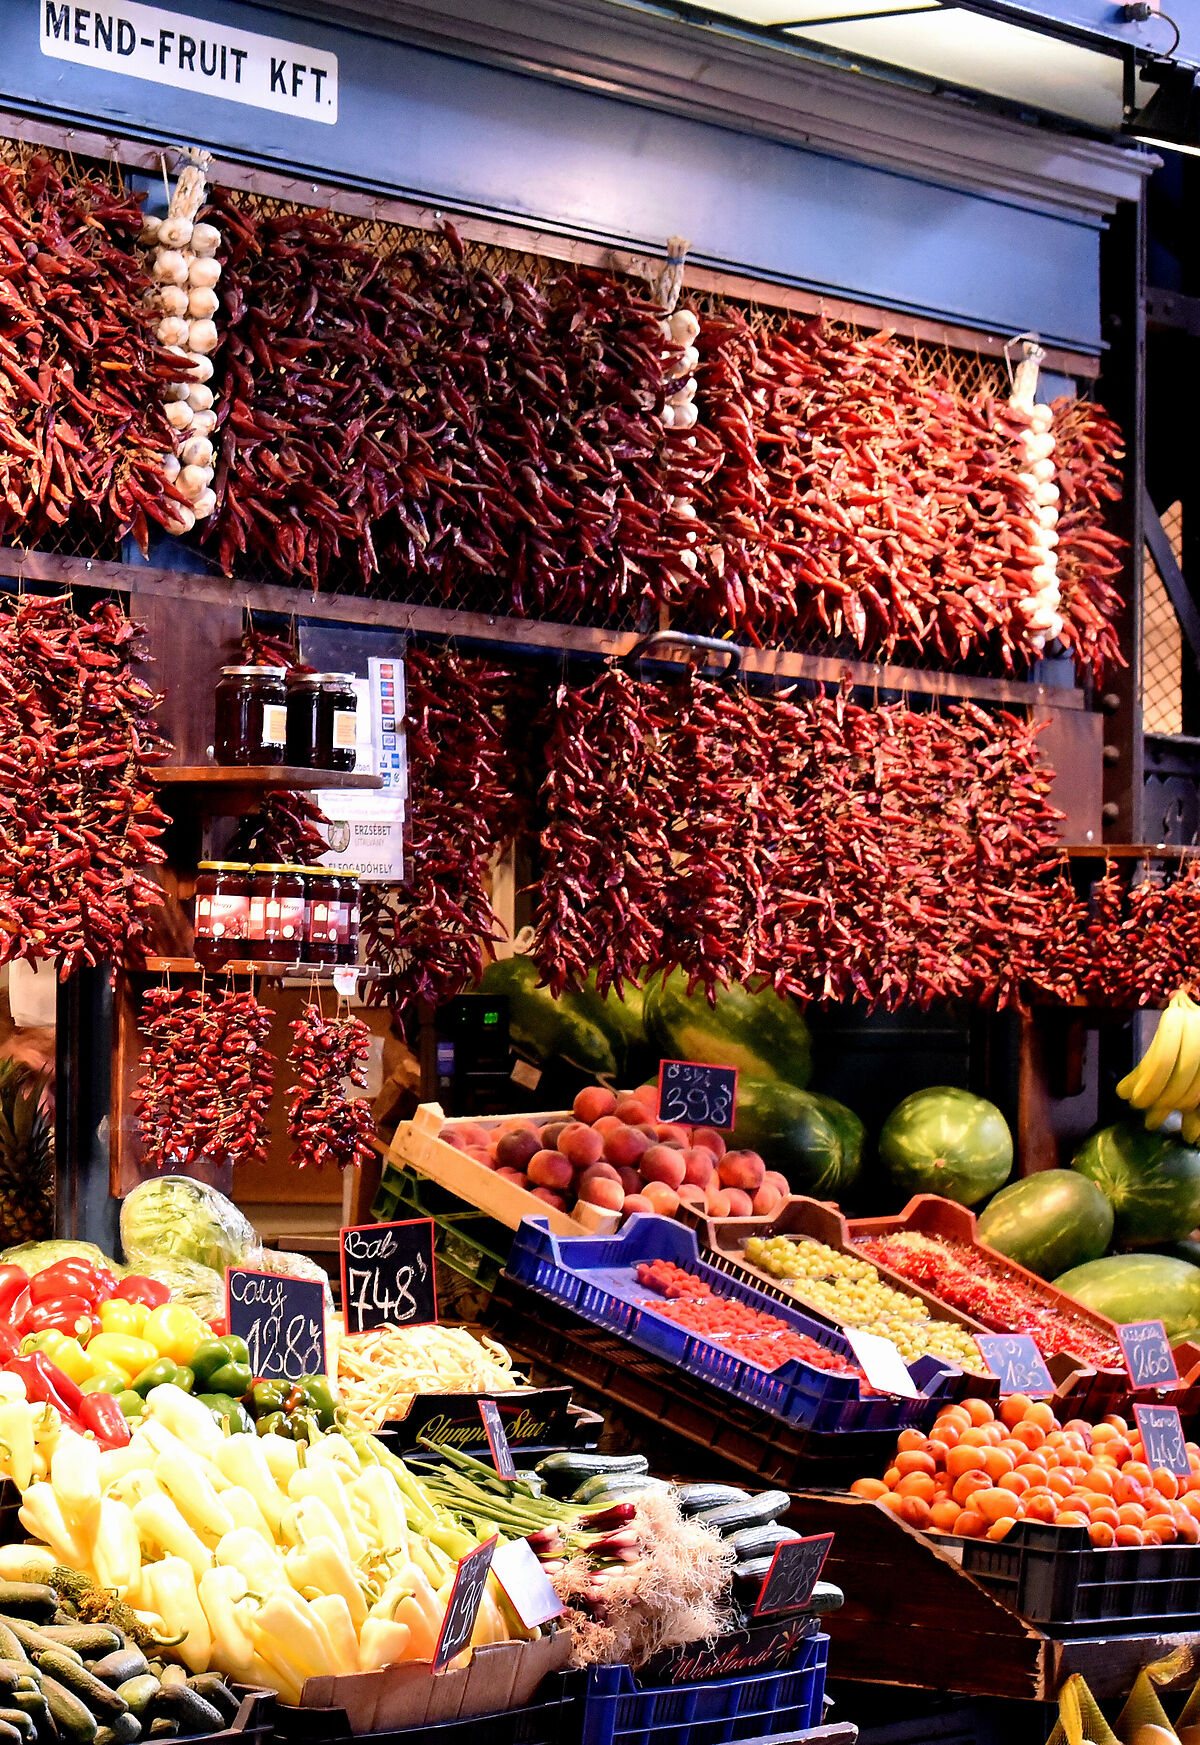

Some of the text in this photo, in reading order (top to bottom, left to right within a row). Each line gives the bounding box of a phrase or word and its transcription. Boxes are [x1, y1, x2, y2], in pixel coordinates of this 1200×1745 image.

[46, 1, 332, 105] MEND-FRUIT KFT.
[354, 823, 392, 836] ERZSÉBET
[656, 1086, 728, 1125] 398
[344, 1230, 399, 1260] Bab
[349, 1265, 418, 1332] 748
[503, 1408, 546, 1440] Star
